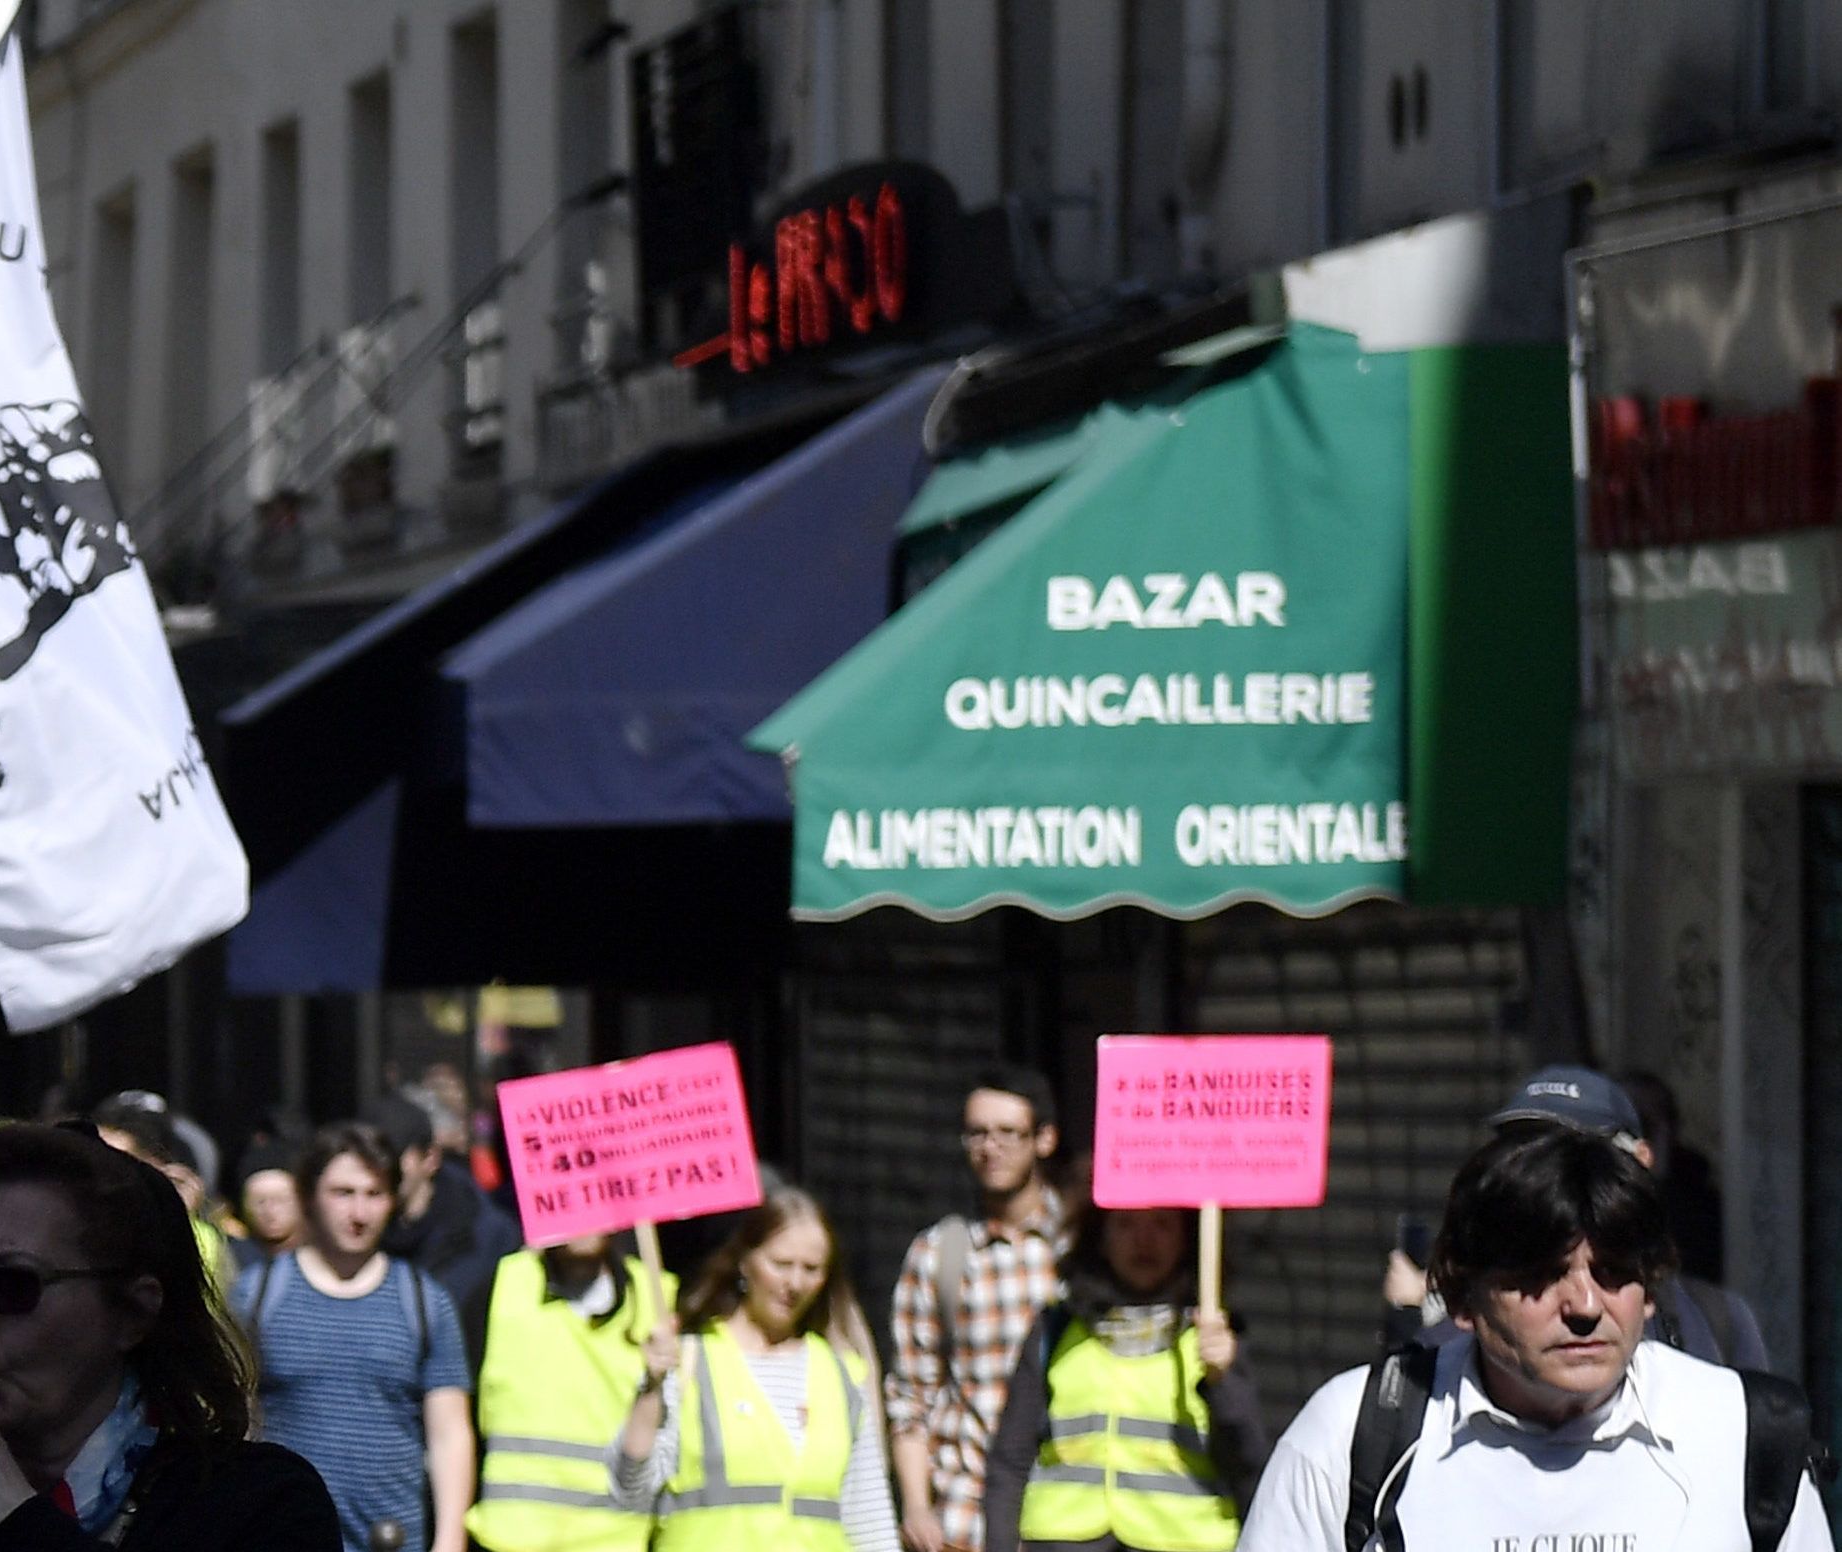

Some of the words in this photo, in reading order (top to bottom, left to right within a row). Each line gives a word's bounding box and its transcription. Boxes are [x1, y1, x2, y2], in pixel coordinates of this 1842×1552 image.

[1046, 570, 1287, 631] BAZAR
[944, 671, 1375, 730] QUINCAILLERIE
[822, 805, 1142, 869] ALIMENTATION
[1174, 799, 1408, 867] ORIENTALE
[538, 1081, 670, 1125] VIOLENCE
[522, 1134, 542, 1153] 5
[552, 1149, 597, 1173] 40
[535, 1186, 572, 1215] NE
[580, 1169, 658, 1206] TIREZ
[666, 1158, 725, 1190] PAS
